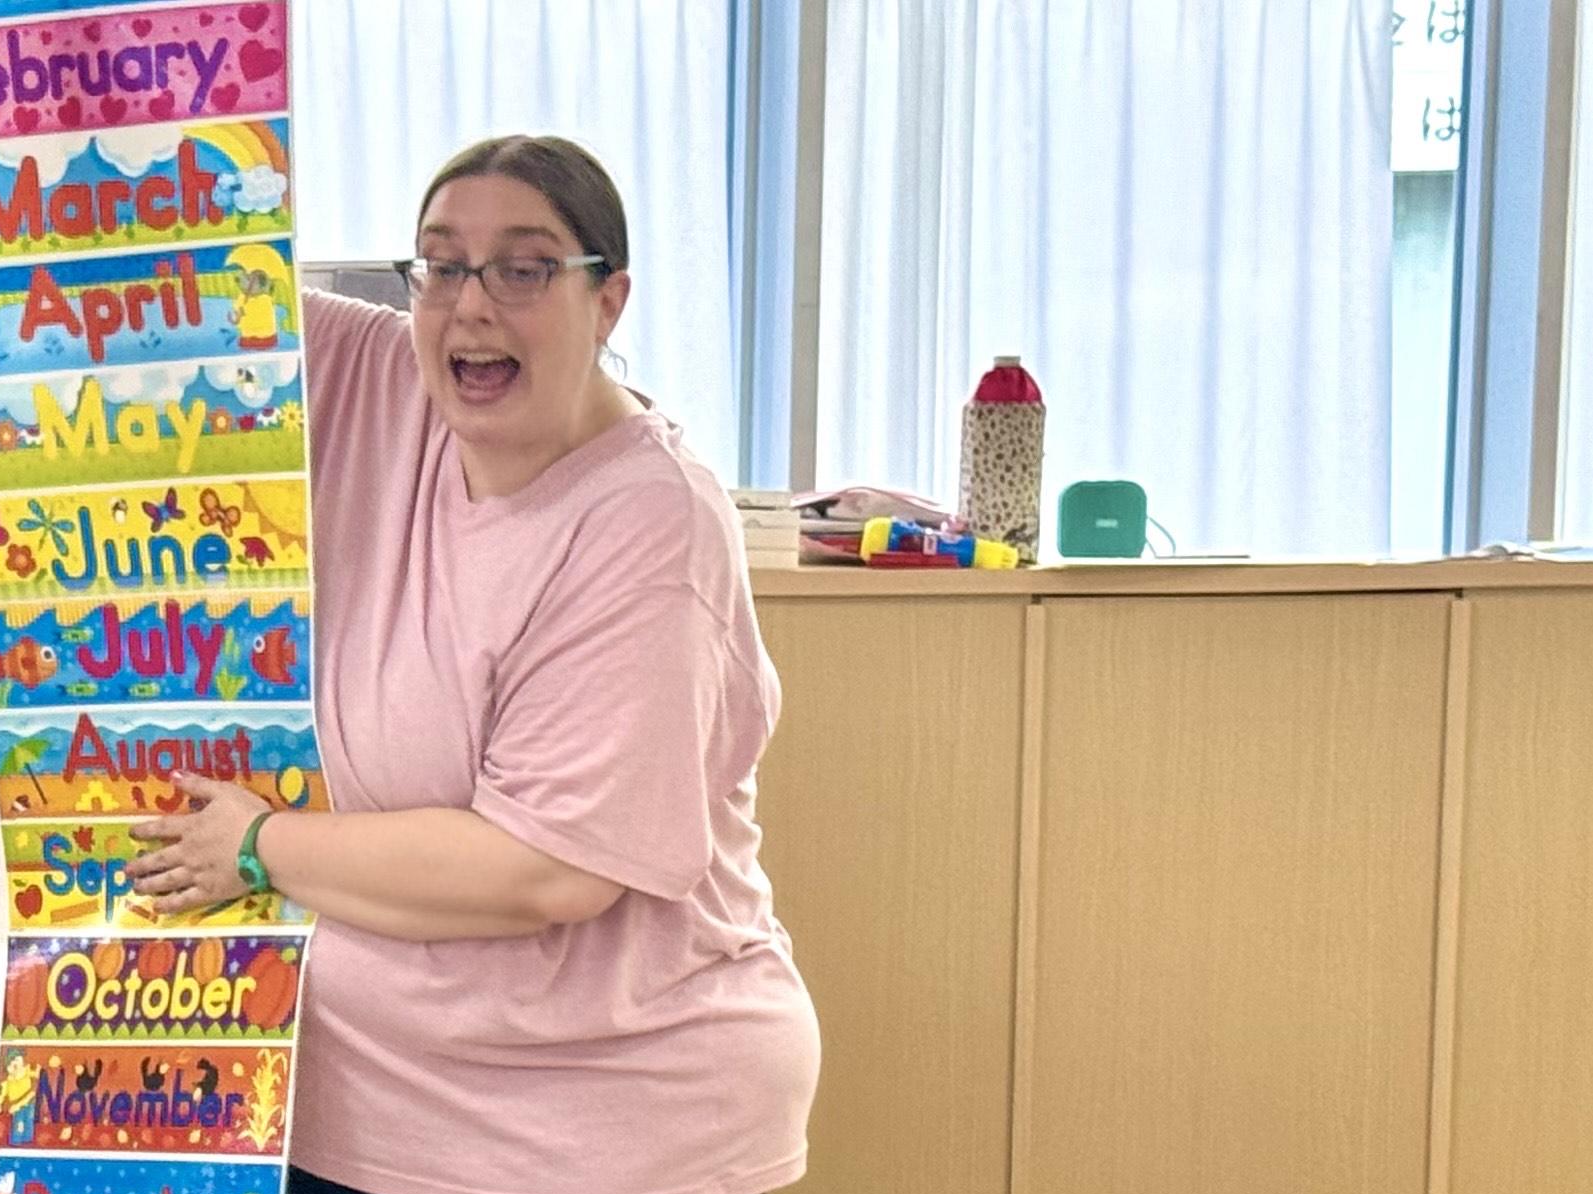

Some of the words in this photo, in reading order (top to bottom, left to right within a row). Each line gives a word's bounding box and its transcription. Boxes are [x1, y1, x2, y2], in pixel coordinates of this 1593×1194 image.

[19, 252, 202, 363] April
[33, 377, 207, 474] May
[50, 505, 232, 591] June
[76, 600, 226, 695] July
[63, 712, 254, 812] August
[46, 950, 258, 1021] October
[33, 1066, 245, 1128] November
